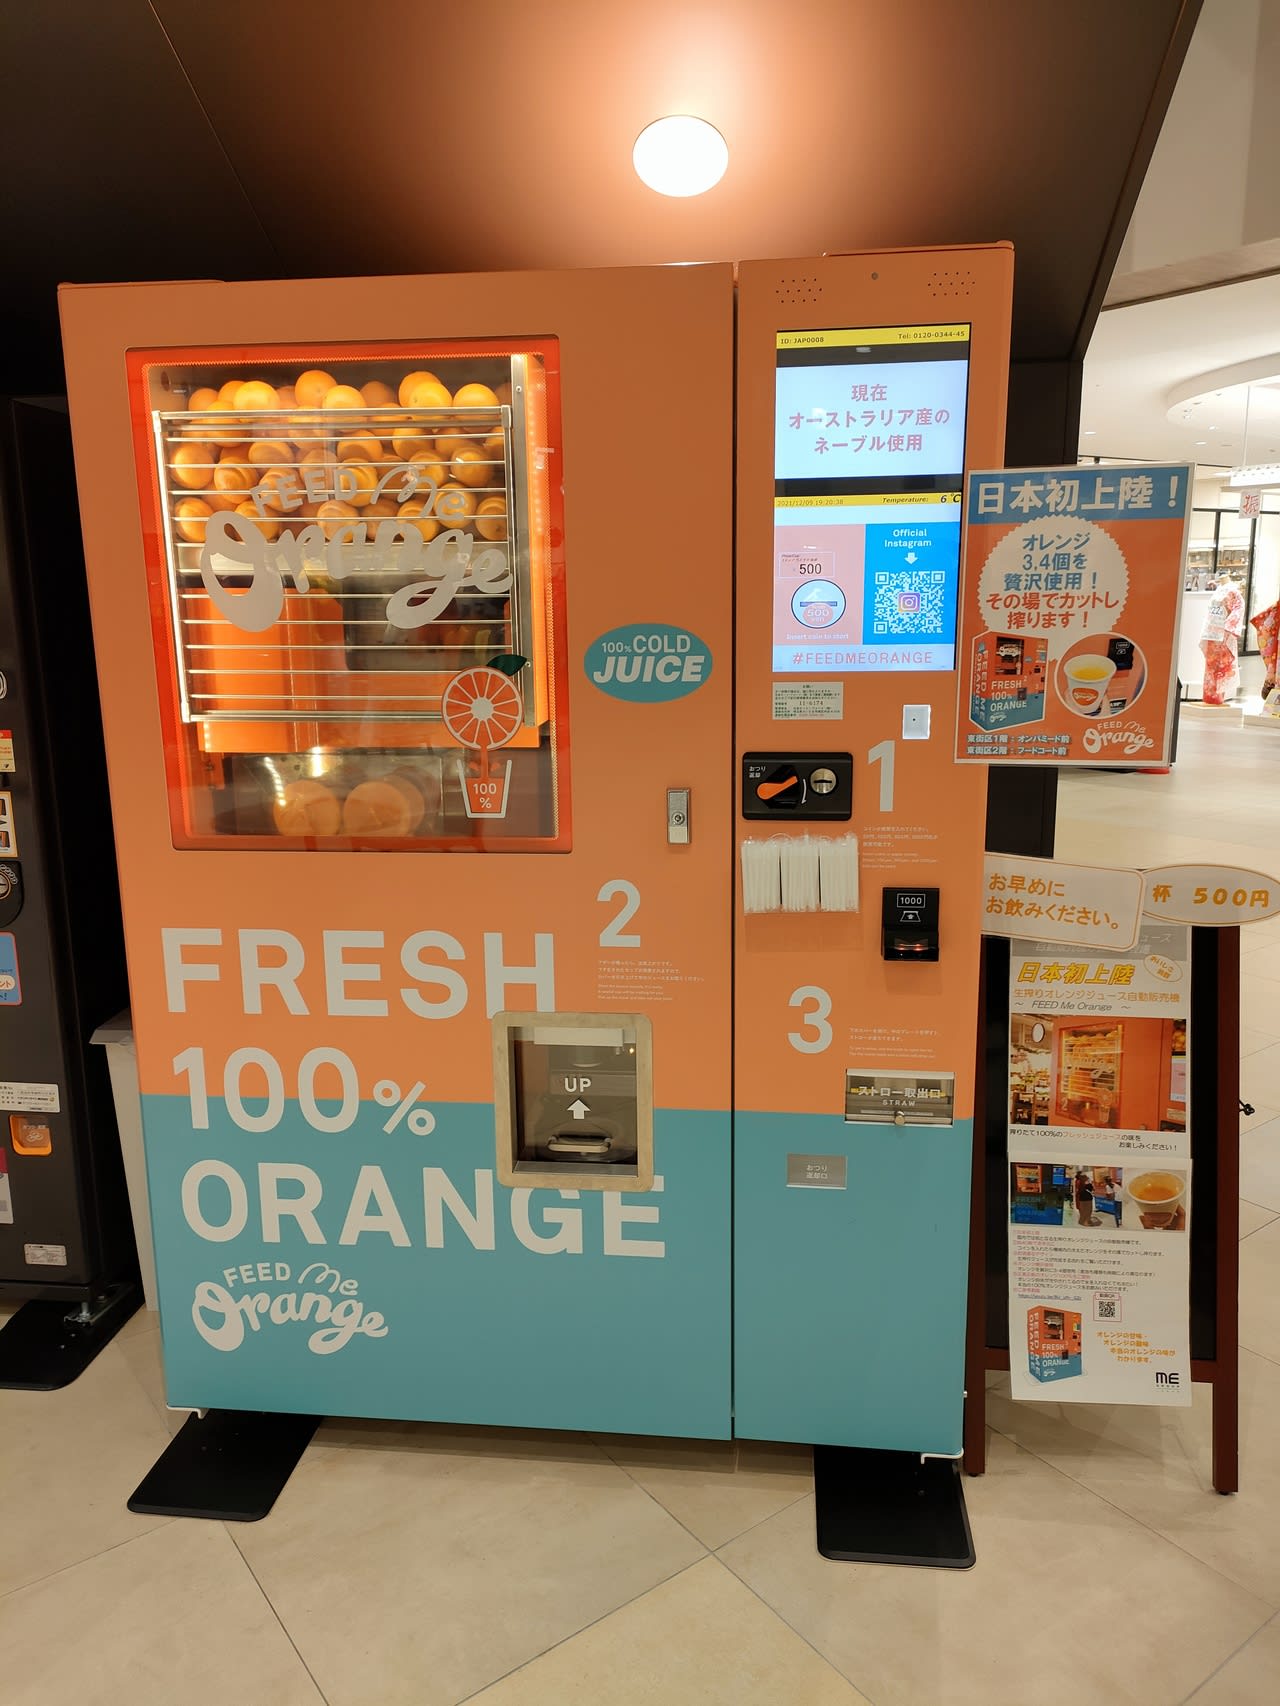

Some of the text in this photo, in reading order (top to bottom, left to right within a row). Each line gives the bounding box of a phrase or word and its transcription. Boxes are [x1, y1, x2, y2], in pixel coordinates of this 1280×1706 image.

[794, 336, 825, 344] JAP0008
[913, 331, 965, 339] 0120-0344-45
[851, 384, 888, 402] 現在
[789, 408, 950, 429] オーストラリア産の
[814, 434, 923, 454] ネーブル使用
[249, 468, 361, 518] FEED
[940, 495, 947, 503] 6
[977, 475, 1180, 515] 日本初上陸！
[892, 529, 928, 538] Official
[1022, 532, 1091, 551] オレンジ
[884, 540, 932, 549] Instagram
[200, 509, 514, 633] Orange
[799, 563, 822, 575] 500
[1003, 571, 1098, 592] 贅沢使用！
[985, 591, 1120, 611] その場でカットし
[1007, 611, 1089, 630] 搾ります！
[601, 635, 692, 654] 100% COLD
[792, 652, 933, 665] #FEEDMEORANGE
[594, 655, 705, 683] JUICE
[991, 680, 1022, 690] FRESH
[1097, 720, 1123, 731] FEED
[1082, 727, 1155, 754] Orange
[866, 740, 896, 813] 1
[472, 782, 498, 796] 100
[479, 797, 494, 809] %
[988, 873, 1066, 897] お早めに
[900, 896, 923, 905] 1000
[1152, 885, 1271, 909] 杯 500円
[597, 879, 642, 948] 2
[986, 895, 1120, 930] お飲みください。
[161, 927, 556, 1021] FRESH
[1016, 962, 1136, 986] 日本初上陸
[1031, 1000, 1113, 1012] FEED Me Orange
[787, 985, 833, 1054] 3
[172, 1046, 436, 1137] 100%
[564, 1077, 592, 1093] UP
[858, 1086, 941, 1099] ストロー取出口
[882, 1099, 916, 1107] STRAW
[806, 1164, 829, 1172] おつり
[181, 1159, 666, 1258] ORANGE
[222, 1261, 291, 1288] FEED
[192, 1280, 389, 1355] Orange
[1041, 1343, 1065, 1352] FRESH
[1155, 1371, 1180, 1385] ME
